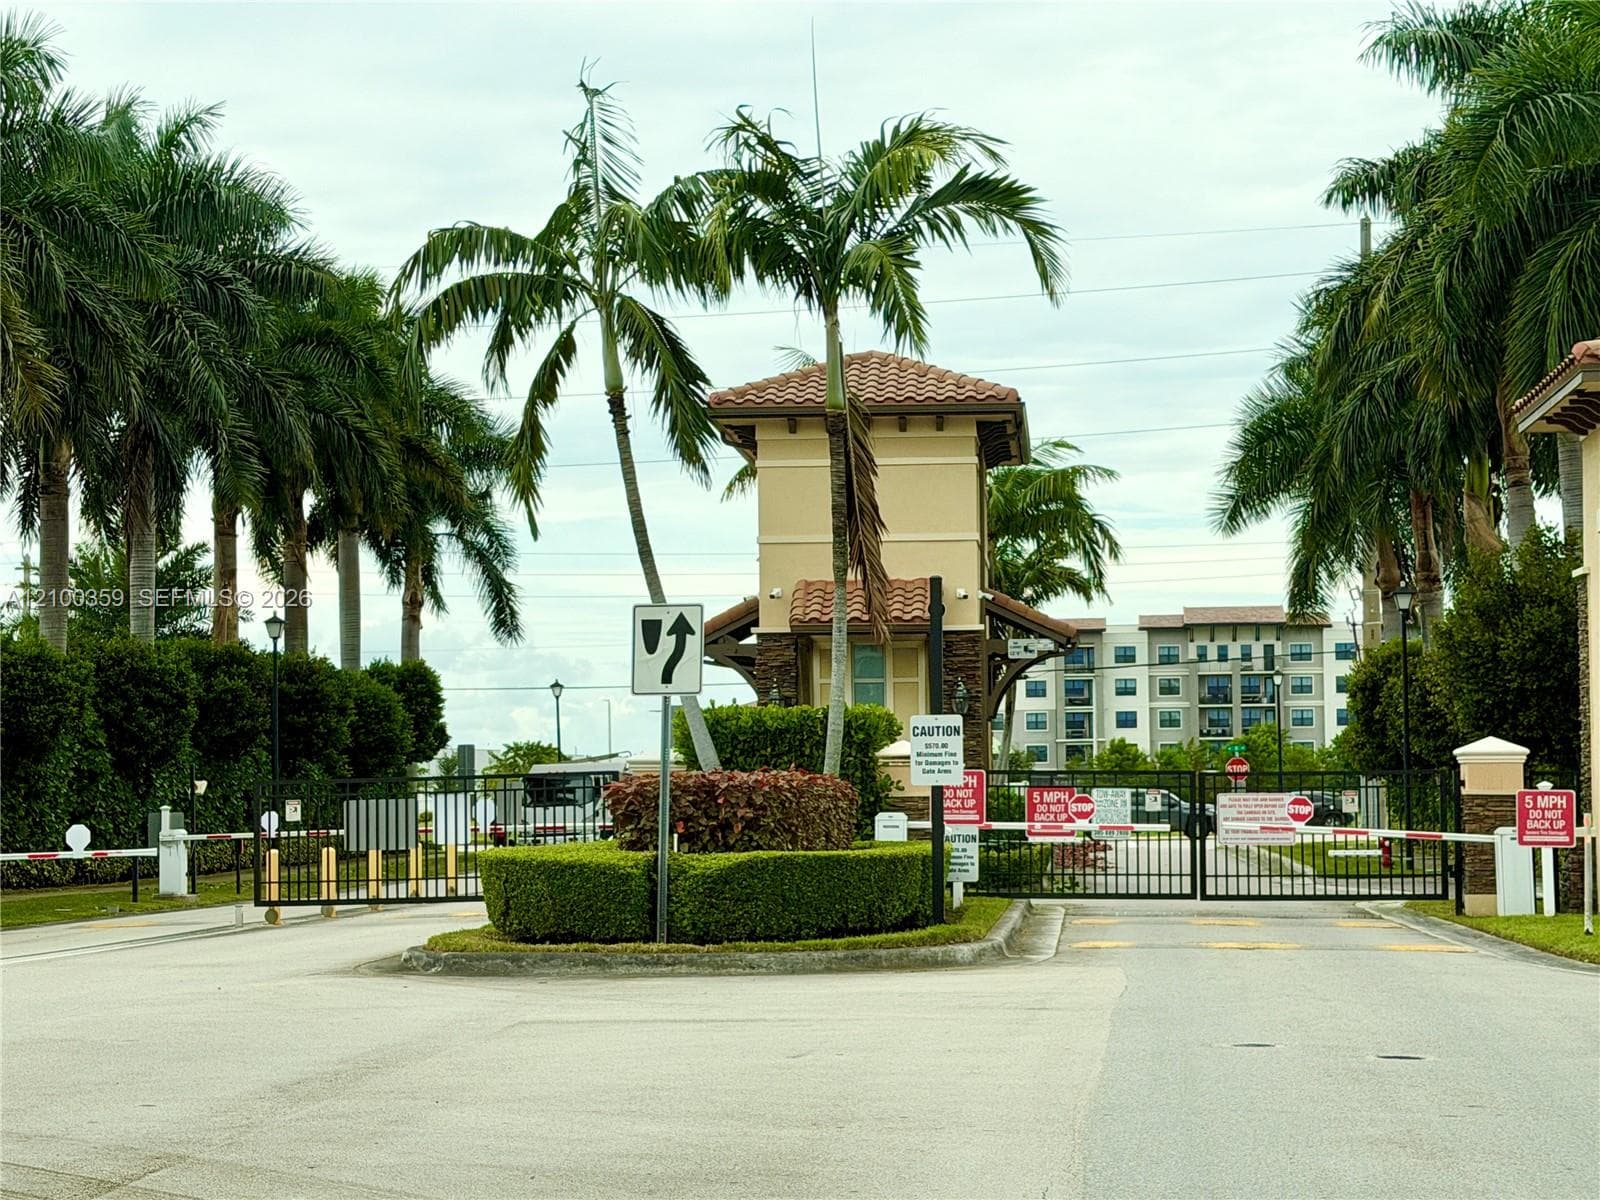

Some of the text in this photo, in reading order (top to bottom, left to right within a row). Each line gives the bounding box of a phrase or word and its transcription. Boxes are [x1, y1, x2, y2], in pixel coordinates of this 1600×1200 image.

[912, 726, 961, 737] CAUTION
[925, 759, 951, 767] Damages
[1227, 764, 1248, 773] STOP
[956, 789, 973, 798] NOT
[1033, 791, 1069, 803] 5 MPH
[943, 799, 977, 808] ACK UP
[1524, 795, 1567, 809] 5 MPH
[1036, 804, 1066, 812] DO NOT
[1070, 803, 1094, 812] STOP
[1287, 804, 1312, 814] STOP
[1034, 813, 1069, 822] BACK UP
[1529, 809, 1563, 819] DO NOT
[1526, 819, 1566, 830] BACK UP
[945, 834, 977, 843] AUTION
